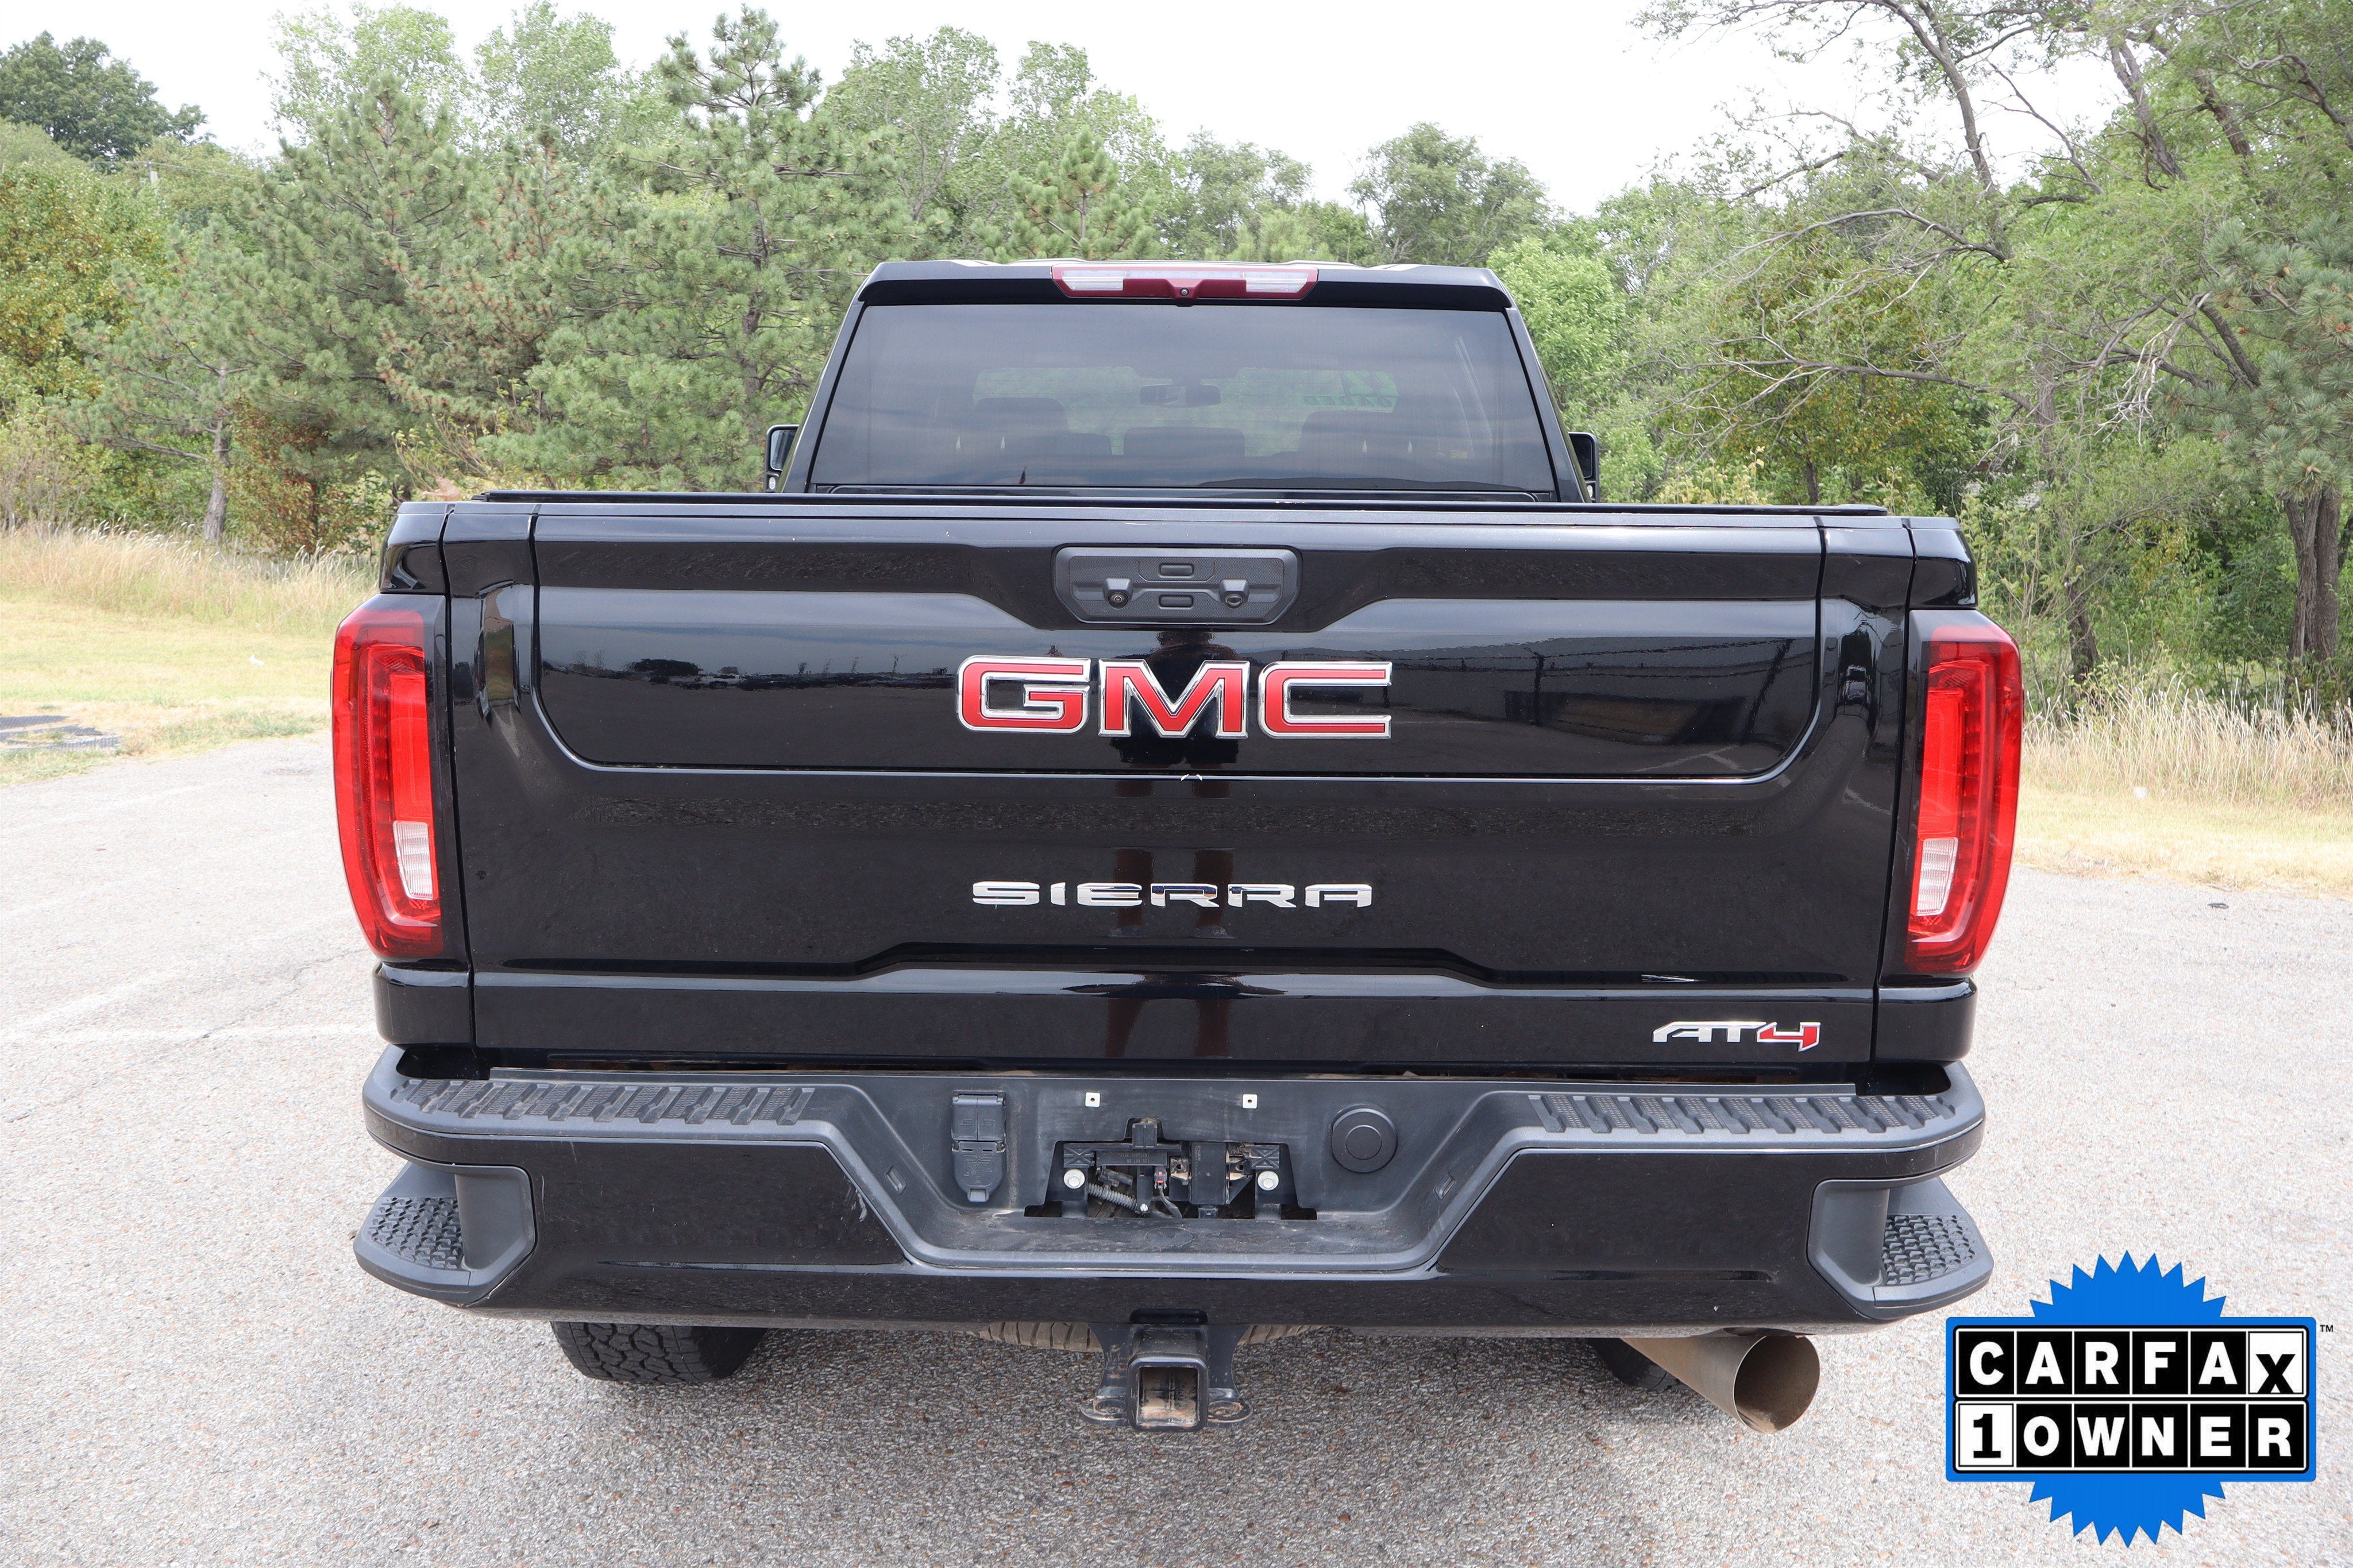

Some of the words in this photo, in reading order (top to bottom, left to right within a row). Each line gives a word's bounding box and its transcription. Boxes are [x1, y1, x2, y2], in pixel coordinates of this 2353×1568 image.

[956, 655, 1392, 739] GMC
[973, 882, 1372, 908] SIERRA
[1653, 1021, 1821, 1052] AT4
